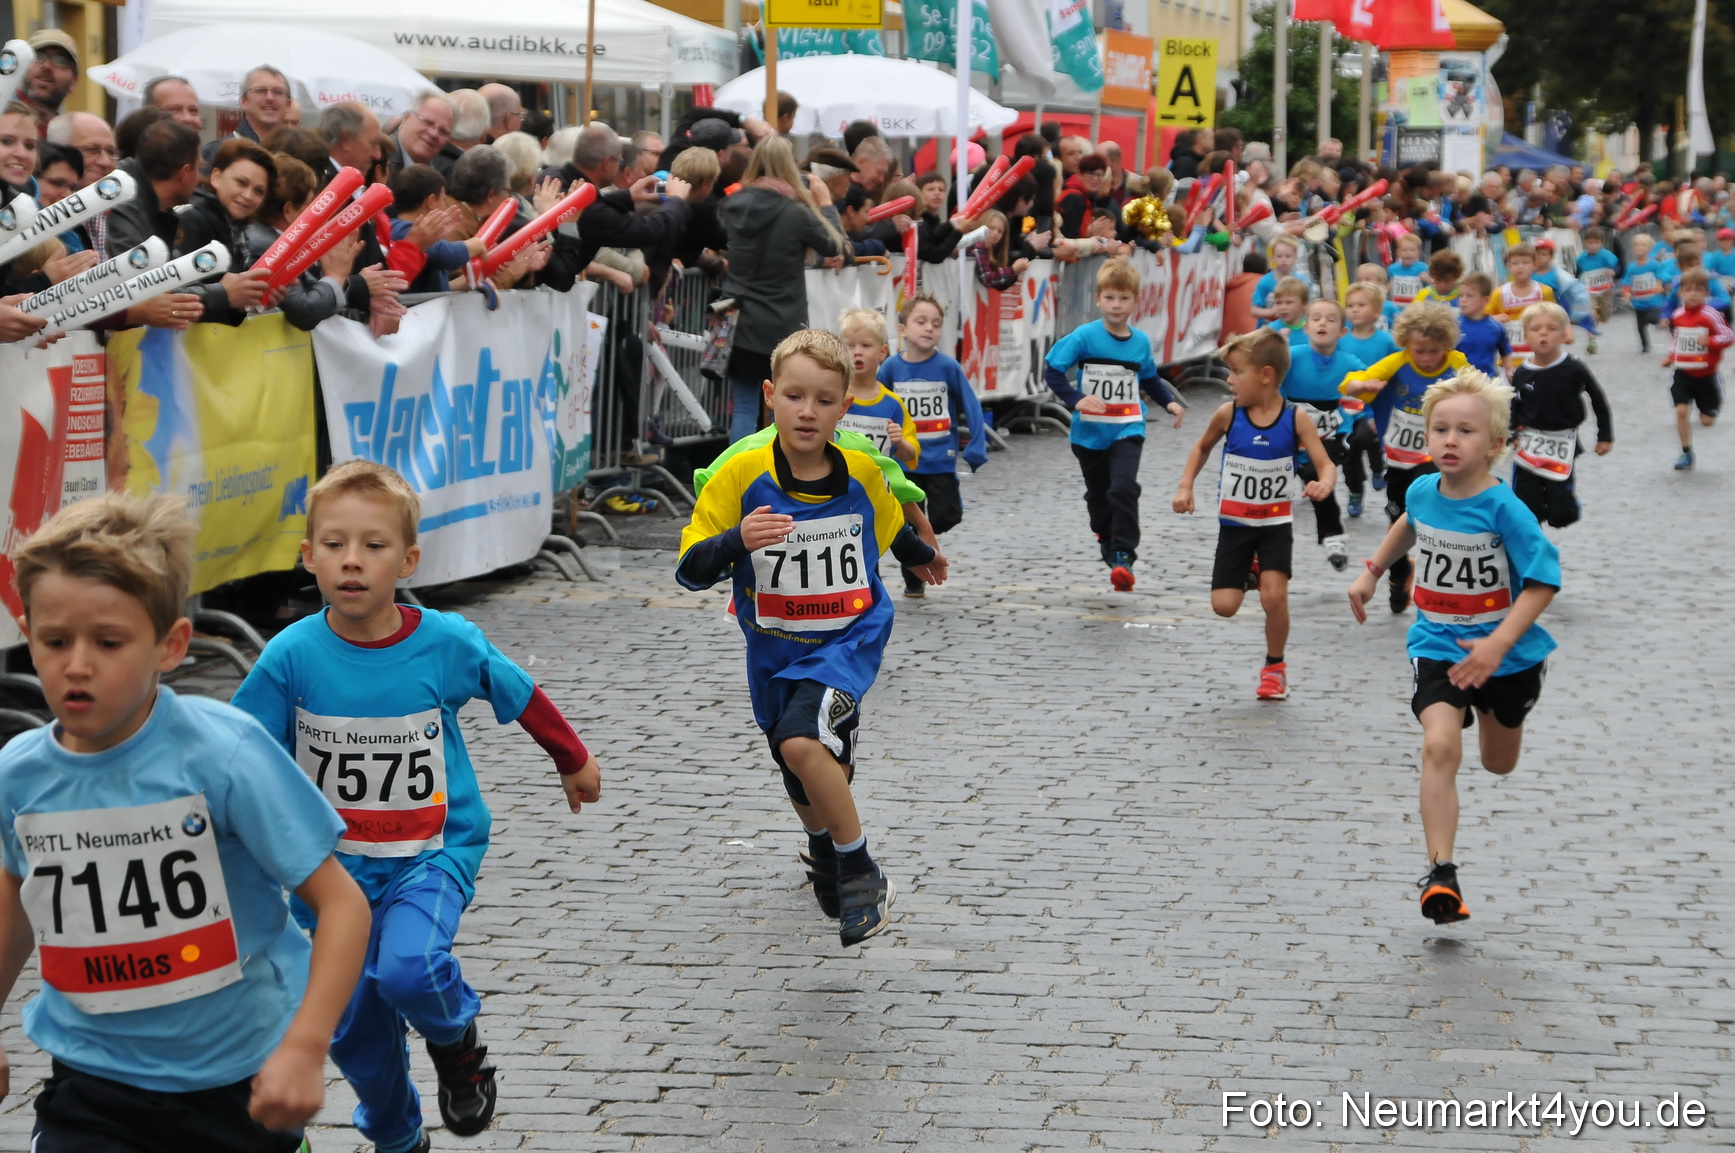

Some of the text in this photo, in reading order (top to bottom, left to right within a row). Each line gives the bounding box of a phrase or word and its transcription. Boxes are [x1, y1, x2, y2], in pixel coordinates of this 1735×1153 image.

[1166, 40, 1211, 56] Block
[1169, 64, 1201, 106] A
[882, 118, 916, 130] BKK
[264, 219, 309, 267] Audi BKK
[309, 229, 333, 250] BKK
[1089, 379, 1133, 400] 7041
[900, 396, 943, 417] 058
[852, 421, 884, 430] Neumarkt
[1520, 434, 1569, 460] 7236
[1226, 461, 1247, 471] PARTL
[1231, 472, 1287, 500] 7082
[797, 528, 848, 543] Neumarkt
[1439, 540, 1487, 552] Neumarkt
[764, 543, 858, 589] 7116
[1420, 548, 1499, 590] 7245
[785, 598, 845, 617] Samuel
[298, 720, 420, 745] PARTL Neumarkt
[309, 745, 434, 803] 7575
[26, 825, 174, 852] PARTL Neumarkt
[33, 849, 208, 934] 7146
[212, 905, 221, 917] K
[84, 953, 172, 985] Niklas
